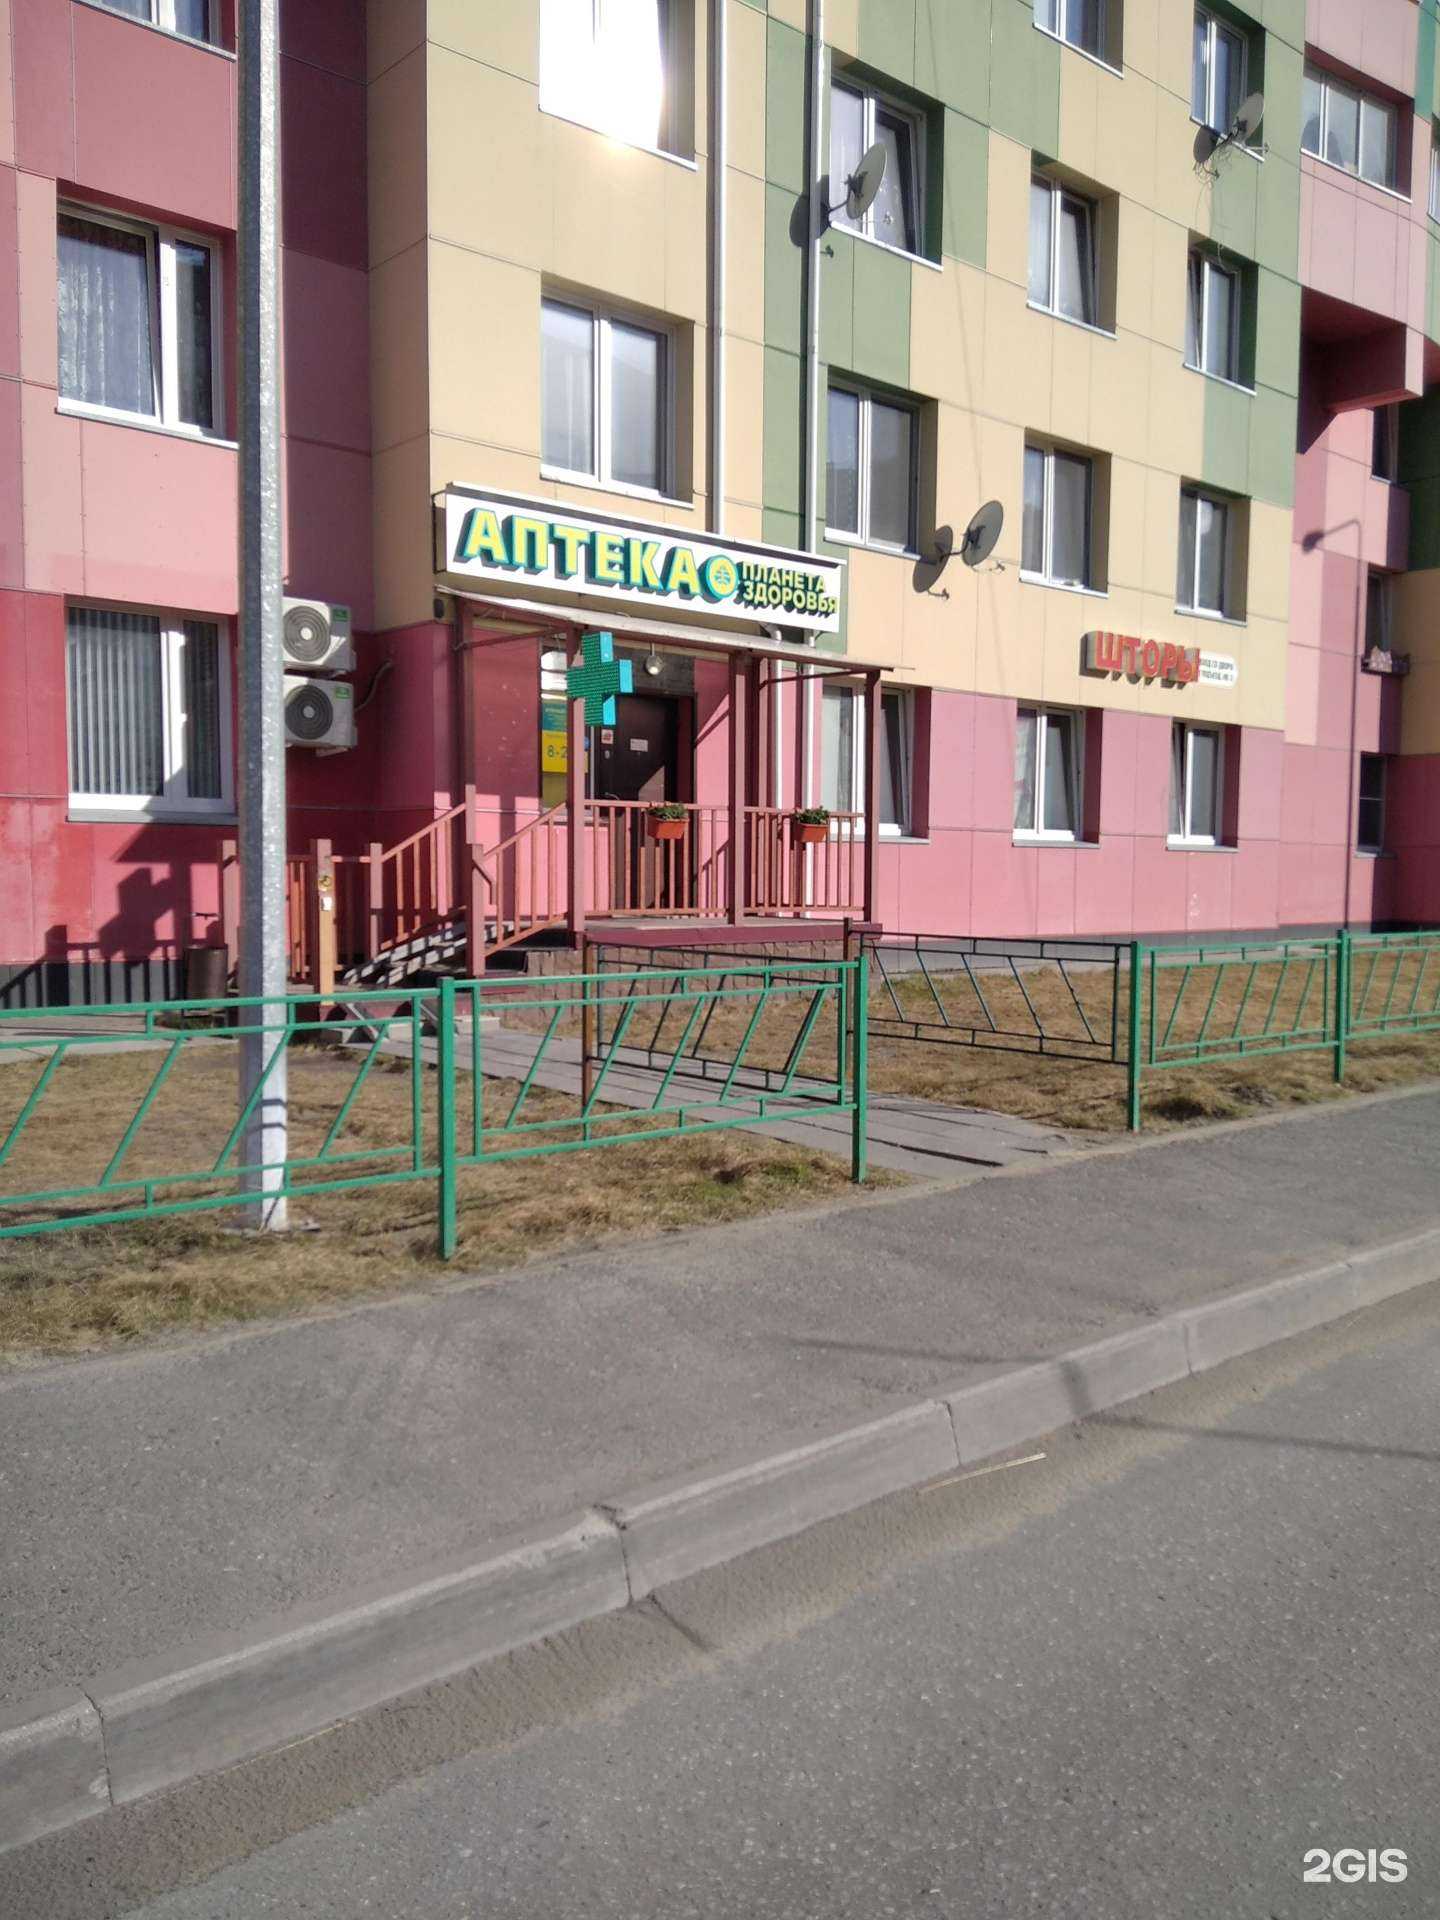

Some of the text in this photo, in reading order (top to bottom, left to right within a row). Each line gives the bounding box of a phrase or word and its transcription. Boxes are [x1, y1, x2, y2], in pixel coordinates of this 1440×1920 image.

[463, 507, 702, 596] АПТЕКА
[742, 560, 826, 593] ПЛАНЕТА
[742, 580, 839, 614] ЗДОРОВЬЯ
[1095, 630, 1200, 683] ШТОРЫ
